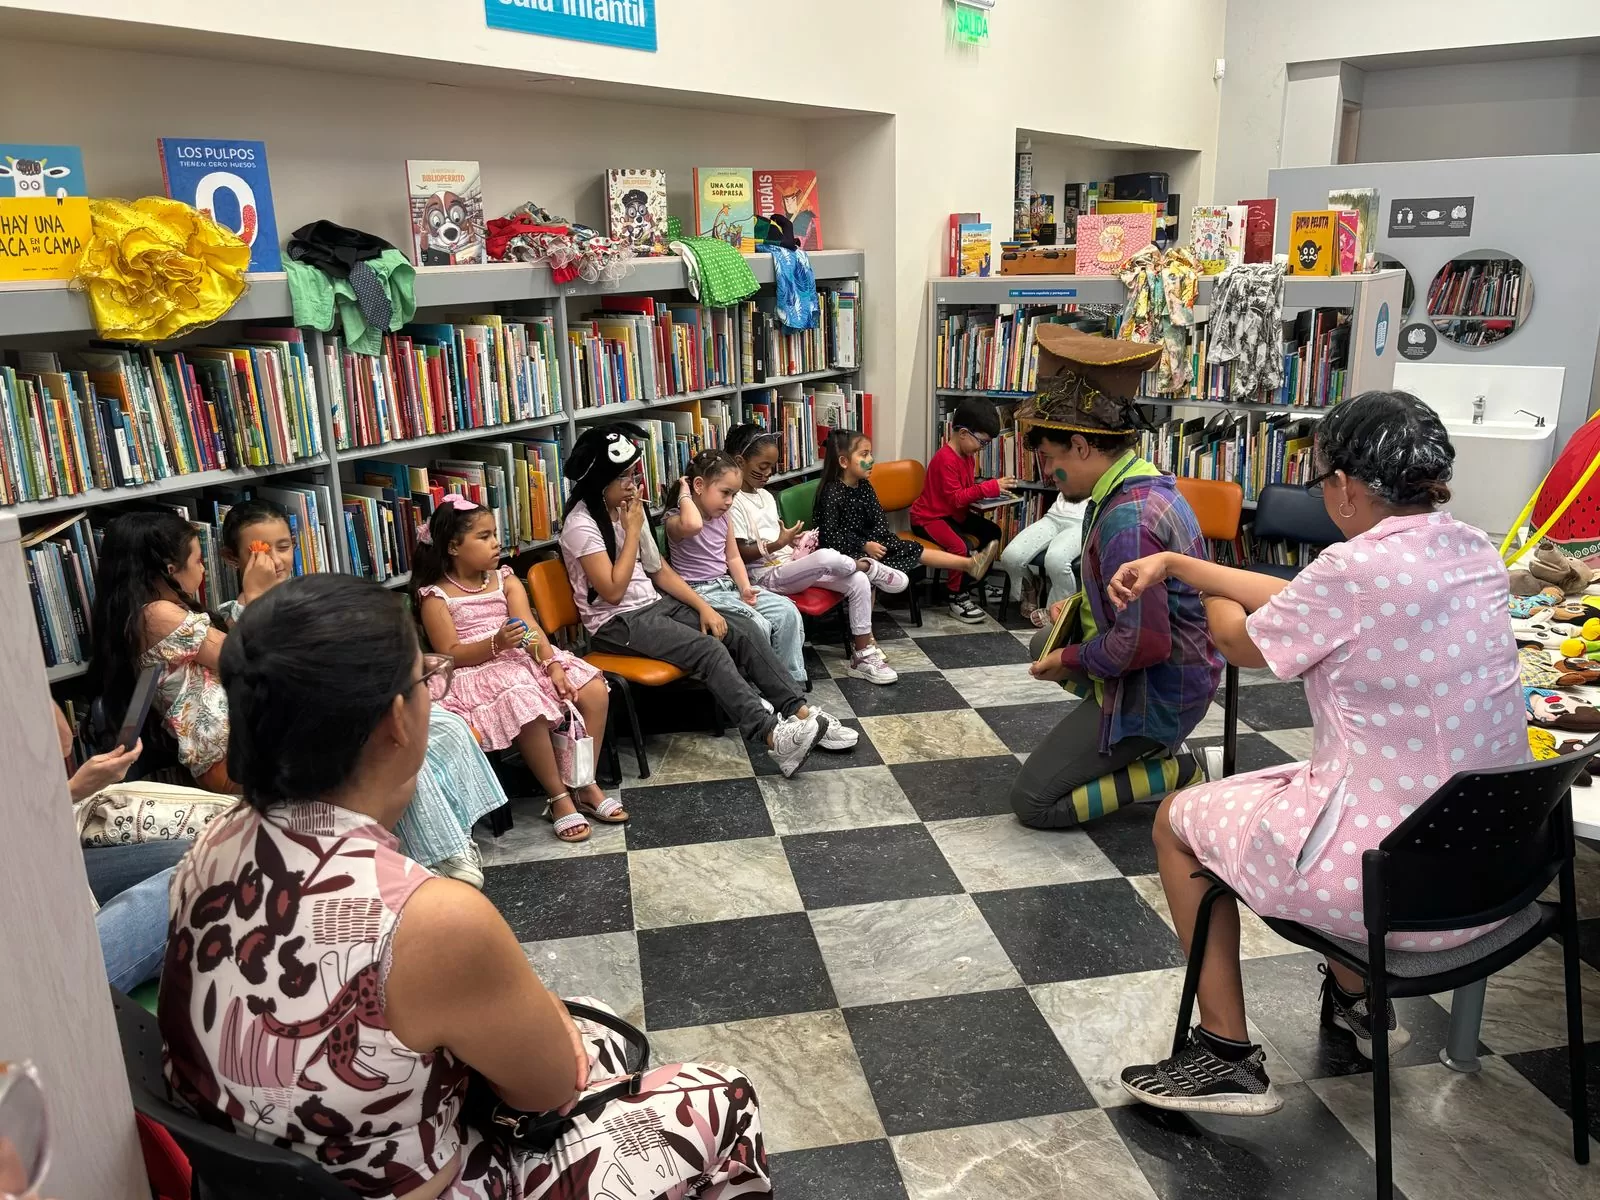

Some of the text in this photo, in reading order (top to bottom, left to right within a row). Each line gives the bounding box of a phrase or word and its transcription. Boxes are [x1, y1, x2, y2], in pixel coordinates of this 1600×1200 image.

[177, 146, 255, 160] LOS PULPOS
[179, 160, 206, 168] TIENEN
[711, 189, 744, 197] SORPRESA
[0, 214, 65, 235] HAY UNA
[0, 237, 29, 256] ACA
[30, 237, 40, 245] EN
[44, 236, 82, 255] CAMA
